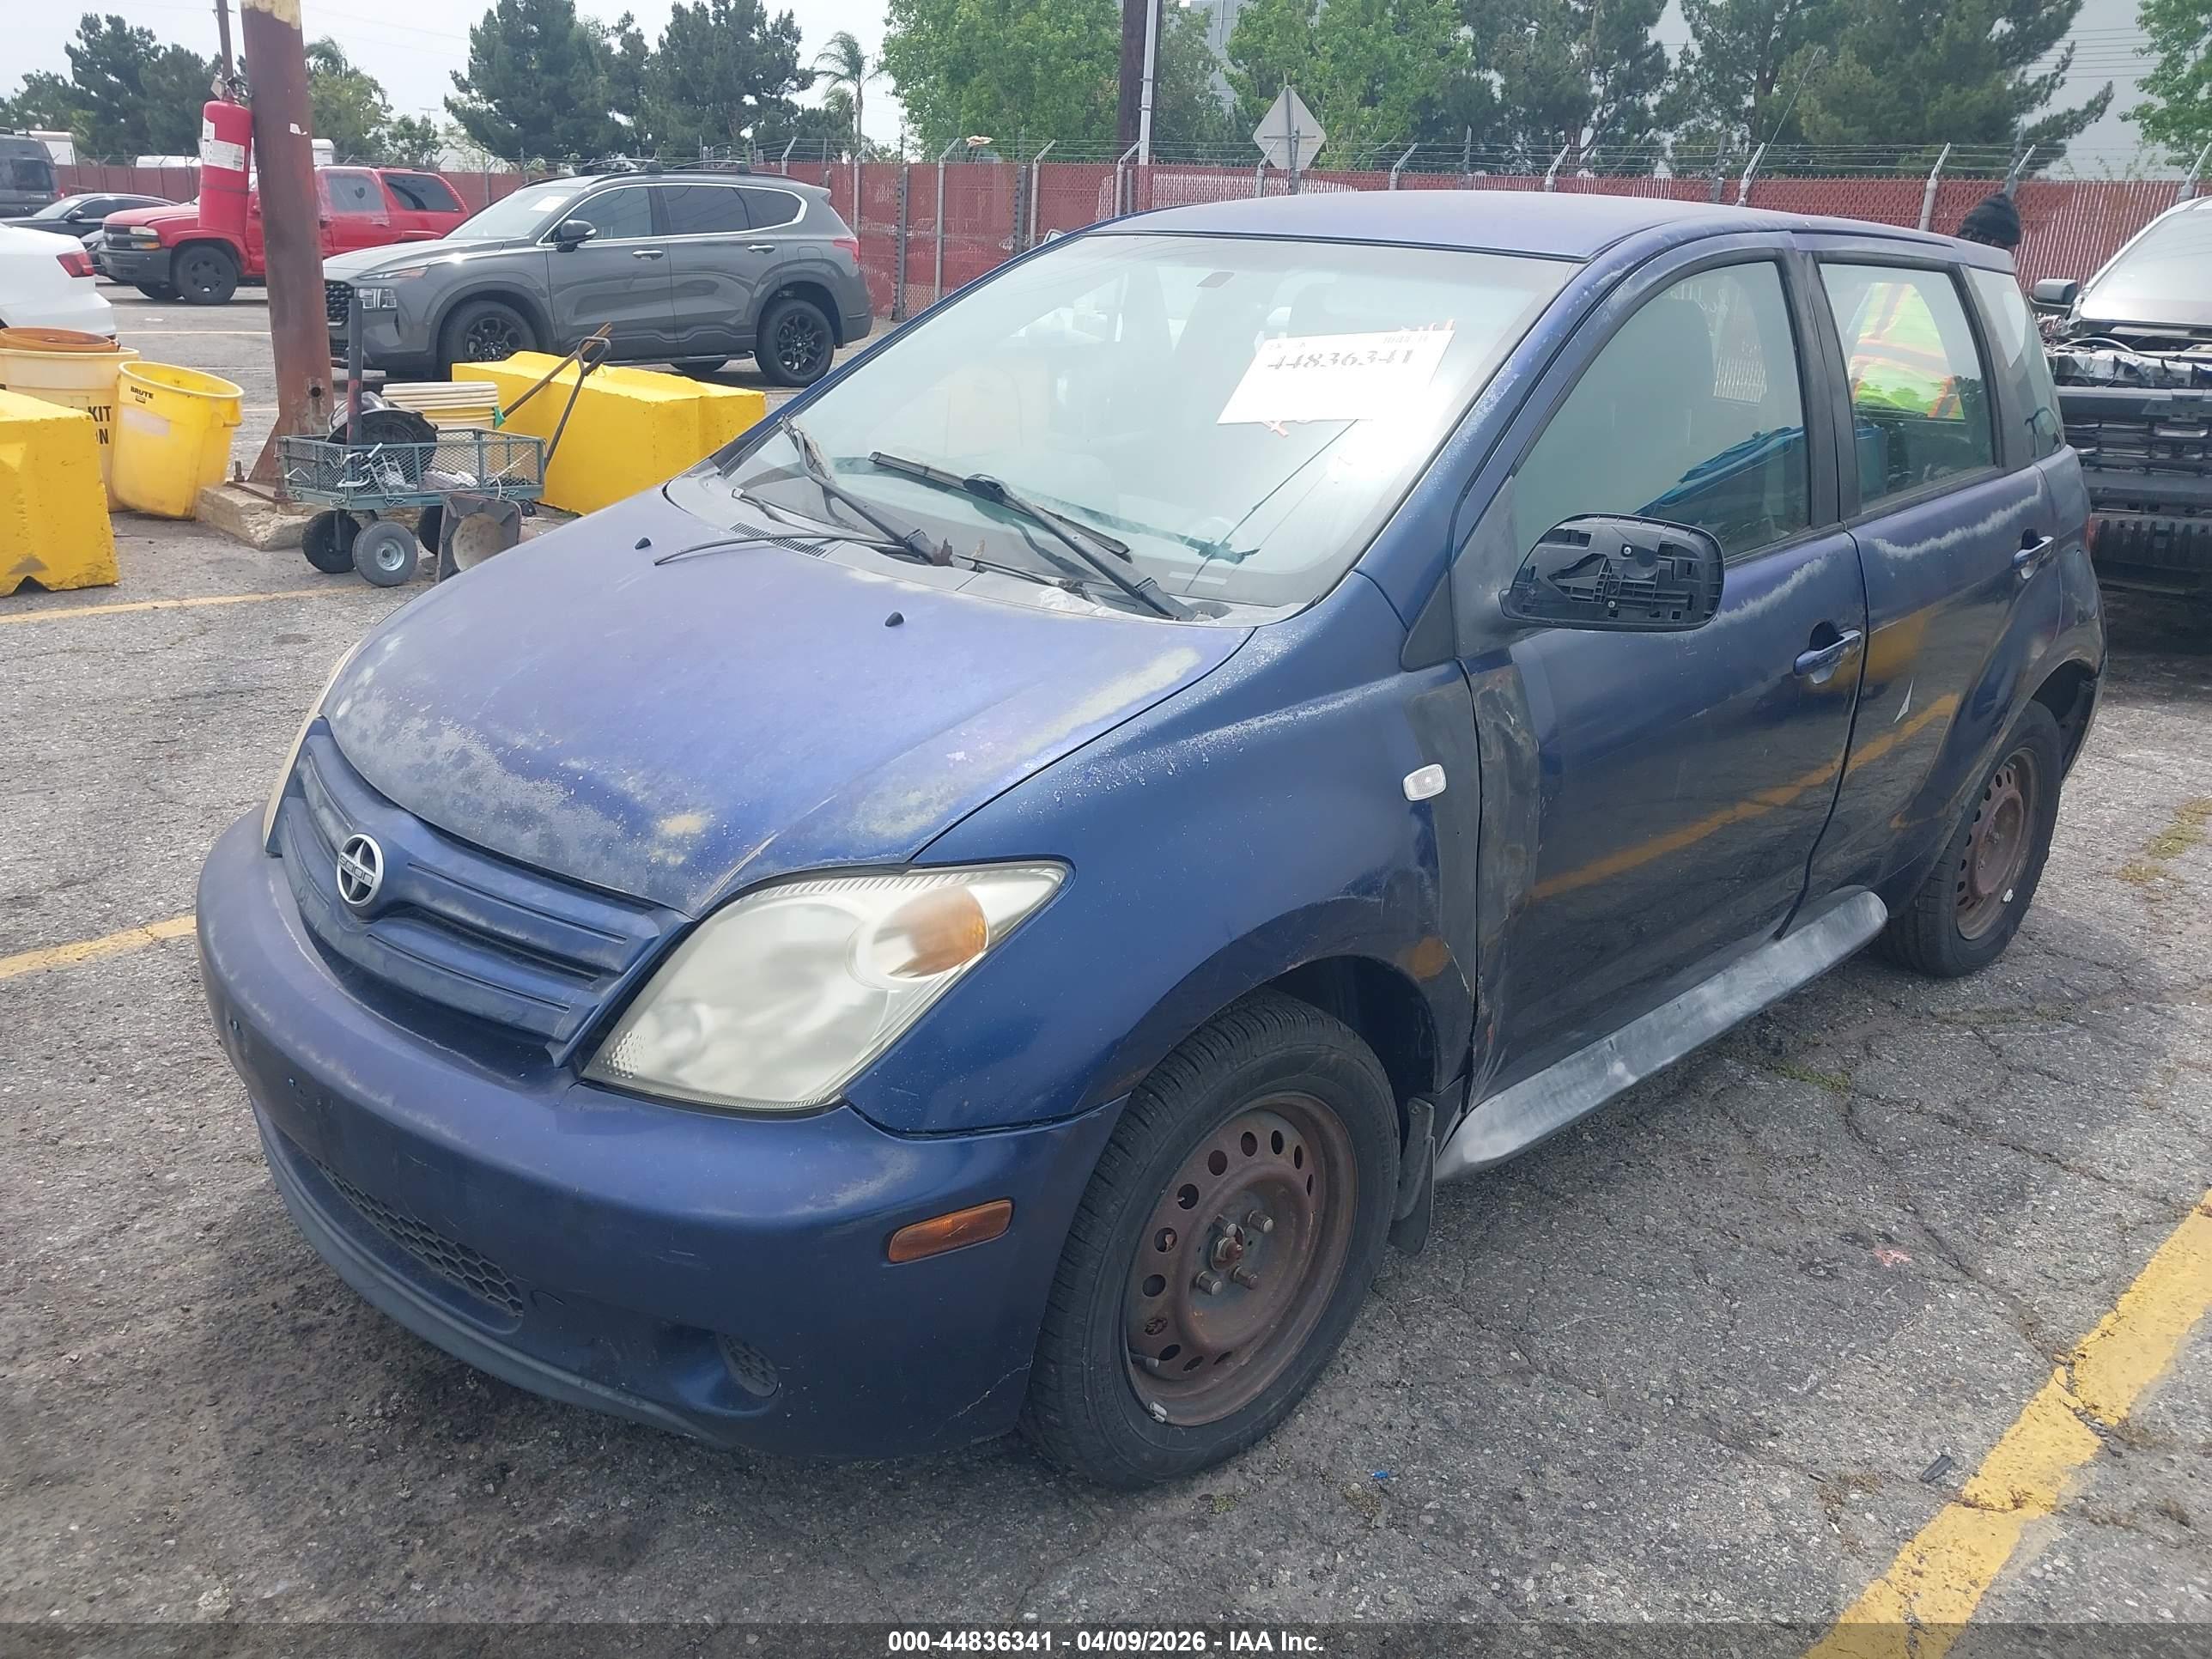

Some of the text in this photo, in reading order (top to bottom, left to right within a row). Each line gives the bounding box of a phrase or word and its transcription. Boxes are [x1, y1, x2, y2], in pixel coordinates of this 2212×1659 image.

[1267, 349, 1415, 370] 44836341
[130, 386, 154, 399] BRUTE
[88, 405, 112, 422] KIT
